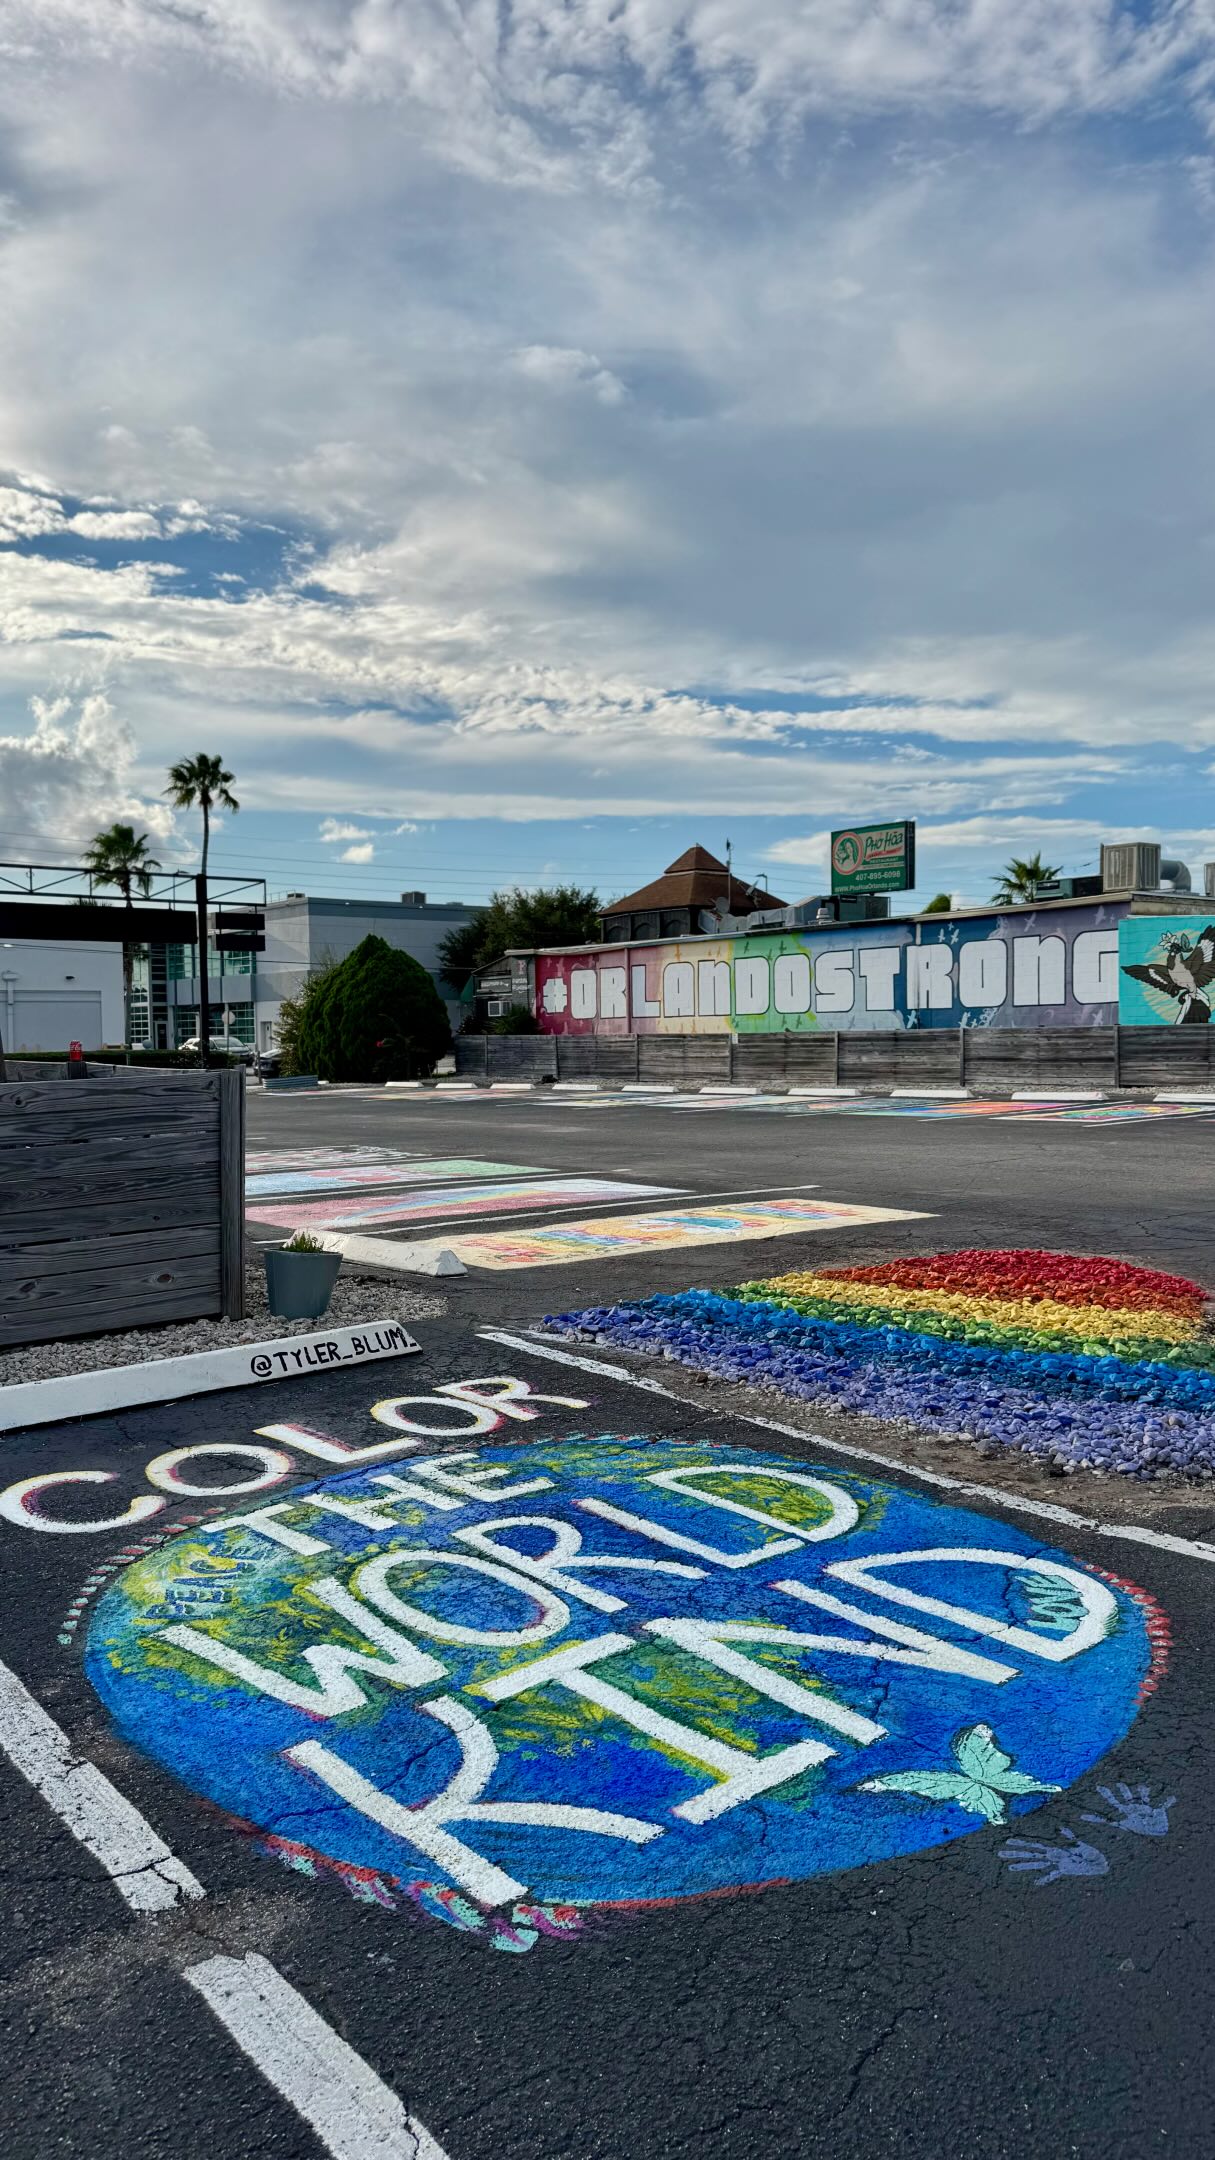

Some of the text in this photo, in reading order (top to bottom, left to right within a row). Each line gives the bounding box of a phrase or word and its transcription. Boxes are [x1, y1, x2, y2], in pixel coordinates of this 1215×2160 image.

[250, 1326, 417, 1377] @TYLER_BLUM_
[0, 1375, 592, 1534] COLOR
[201, 1452, 554, 1556] THE
[158, 1462, 861, 1719] WORLD
[284, 1546, 1117, 1907] KIND
